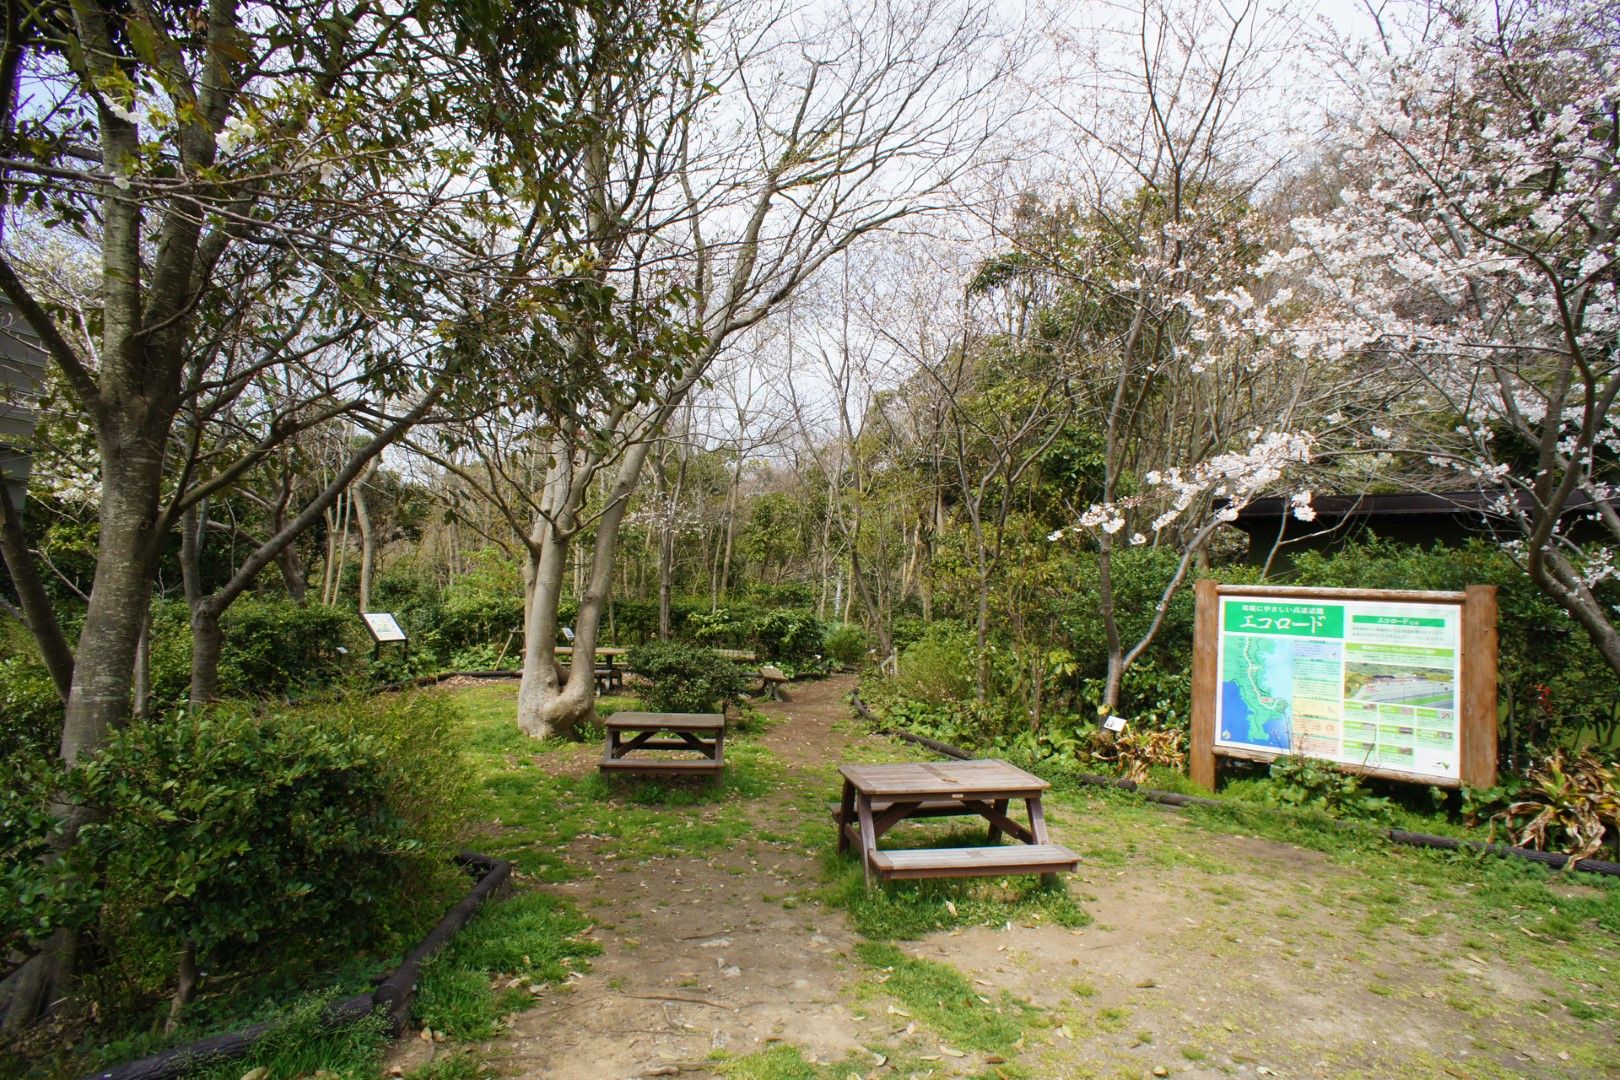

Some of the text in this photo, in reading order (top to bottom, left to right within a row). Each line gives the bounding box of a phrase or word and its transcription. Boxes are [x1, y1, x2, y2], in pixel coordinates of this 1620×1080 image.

[1239, 615, 1326, 634] エコロード
